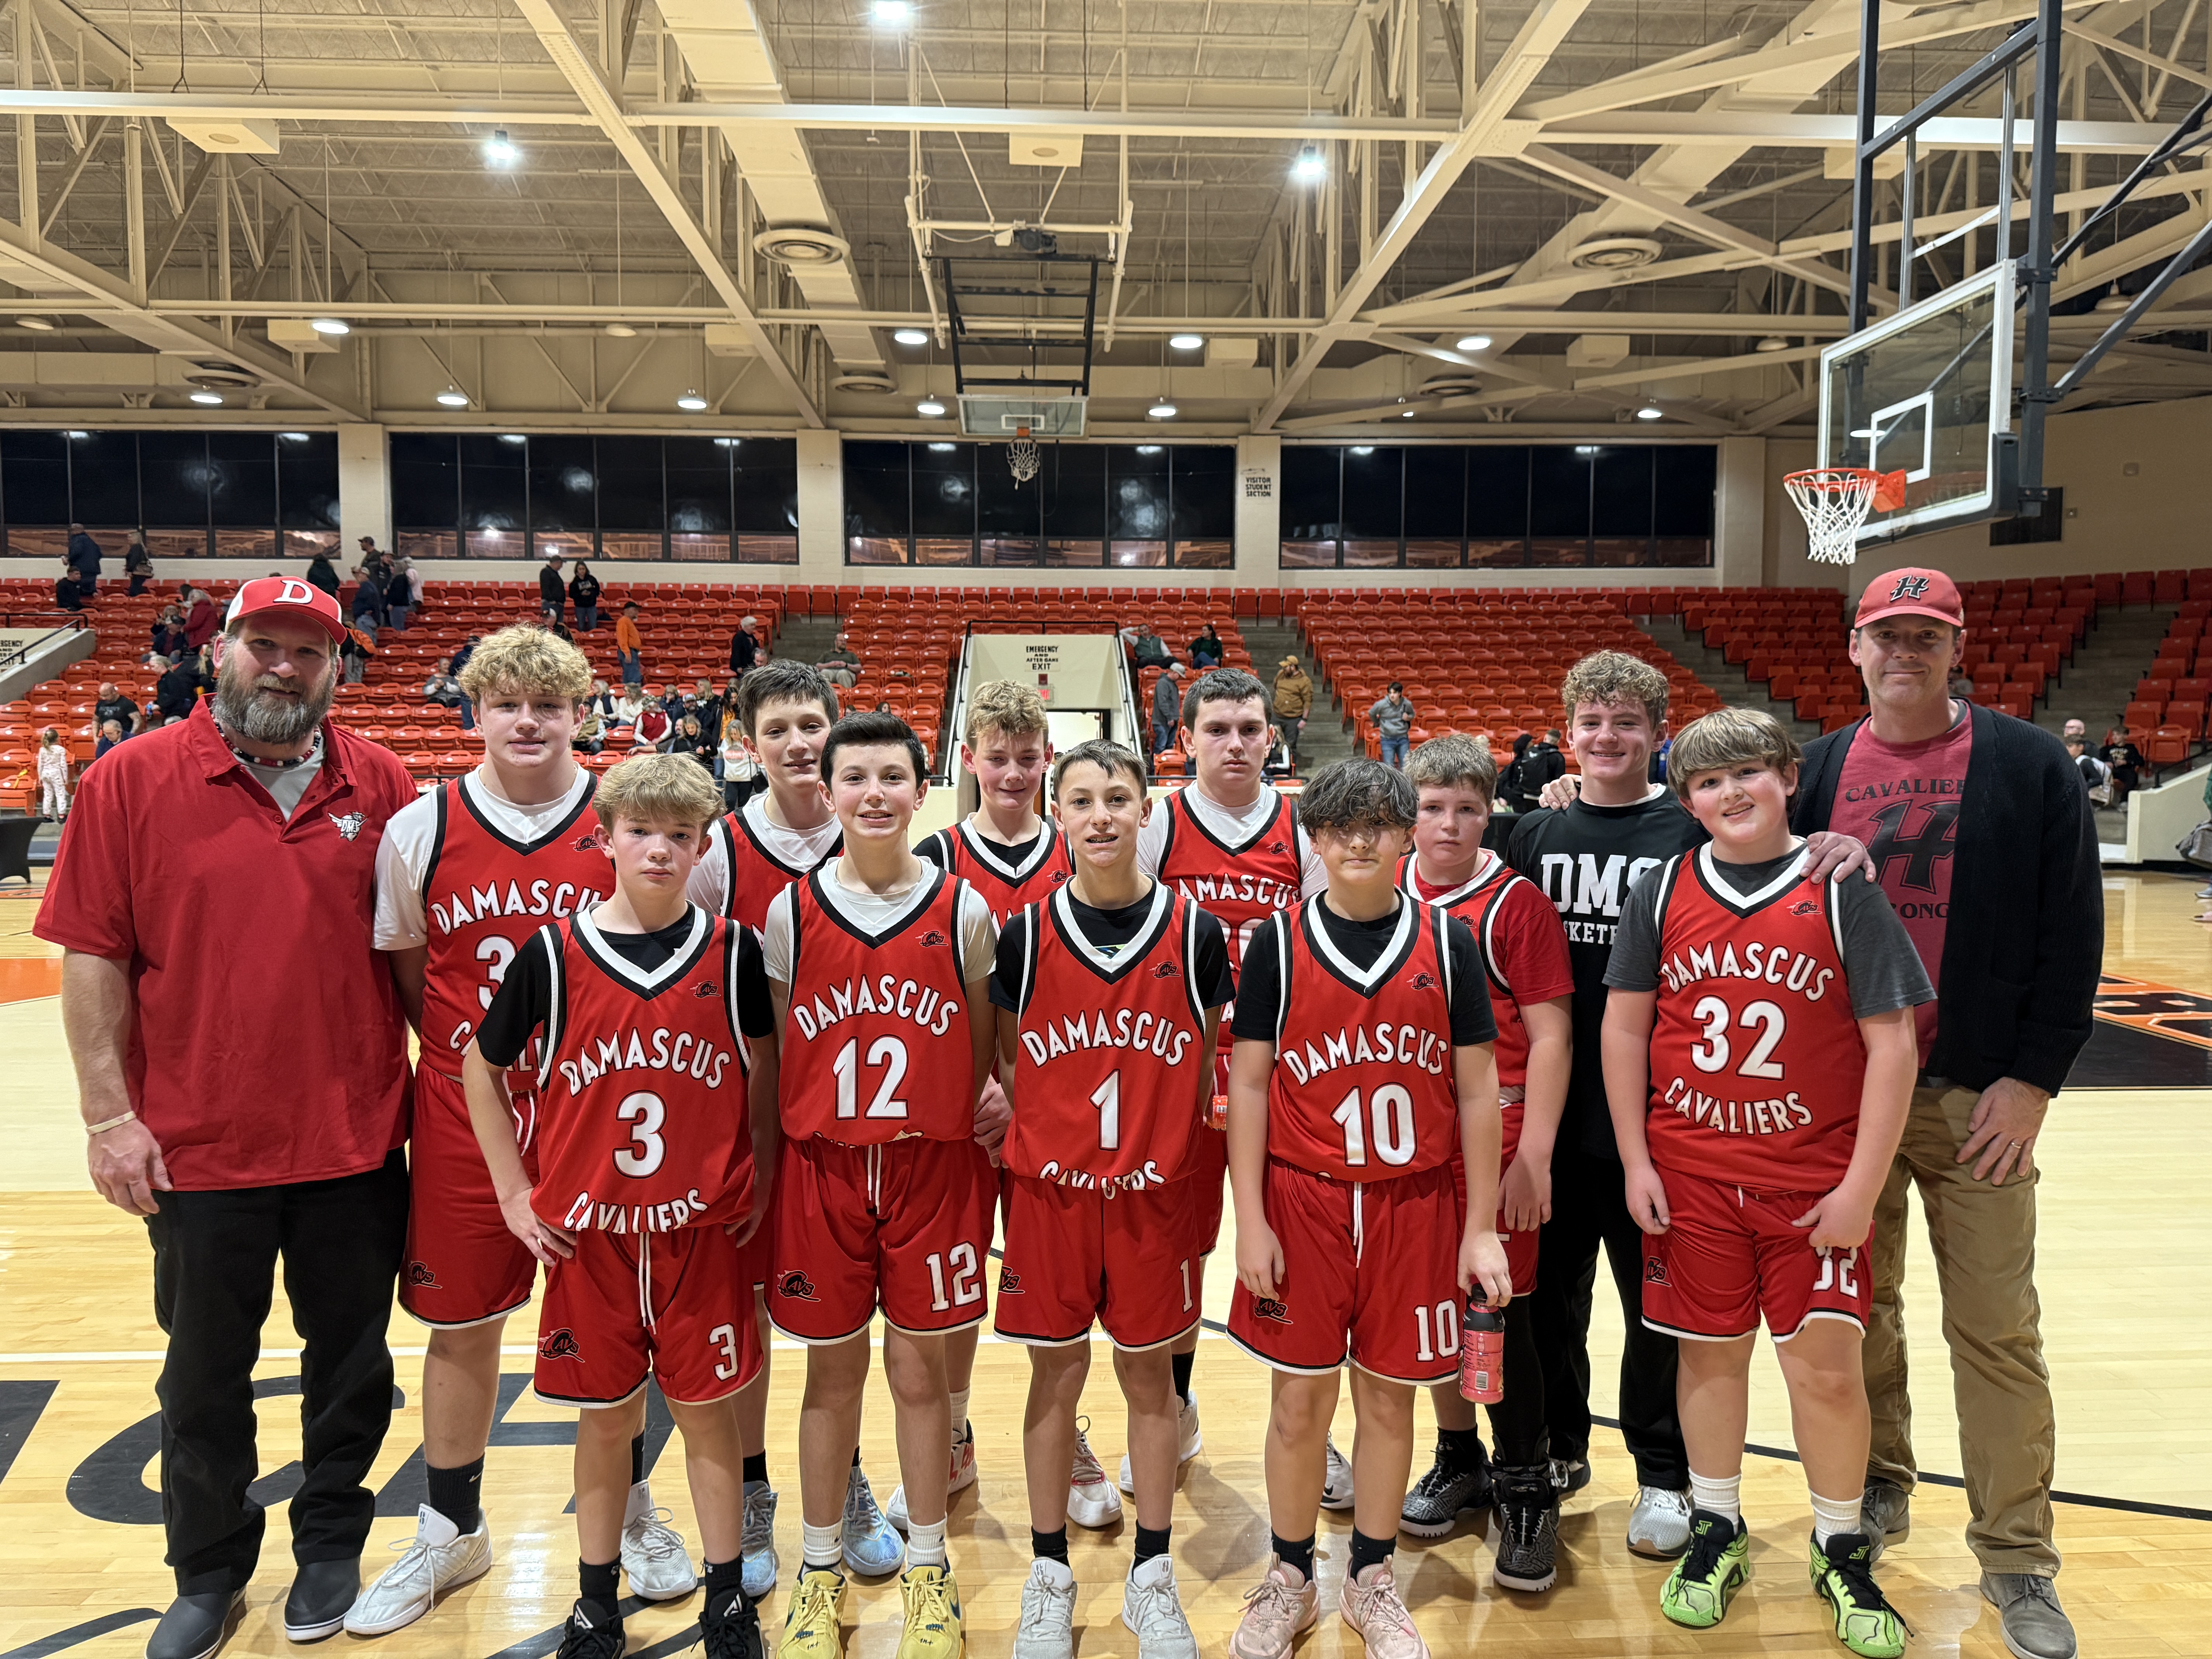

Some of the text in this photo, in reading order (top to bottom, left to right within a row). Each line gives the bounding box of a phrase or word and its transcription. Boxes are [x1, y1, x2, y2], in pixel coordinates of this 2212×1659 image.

[273, 580, 313, 604] D
[1890, 575, 1930, 602] H
[921, 930, 945, 947] CAVS
[696, 981, 718, 998] CAVS
[1155, 961, 1178, 978] CAVS
[1412, 972, 1434, 990] CAVS
[1661, 941, 1834, 1002] DAMASCUS
[793, 974, 959, 1042] DAMASCUS
[1020, 1008, 1193, 1068] DAMASCUS
[1690, 994, 1786, 1081] 32
[558, 1027, 731, 1097] DAMASCUS
[833, 1034, 908, 1120] 12
[1281, 1022, 1448, 1087] DAMASCUS
[613, 1089, 666, 1179] 3
[1089, 1068, 1120, 1151] 1
[1330, 1082, 1417, 1167] 10
[1664, 1076, 1813, 1135] CAVALIERS
[778, 1270, 815, 1297] CAVS
[924, 1241, 982, 1313] 12
[1179, 1258, 1194, 1314] 1
[542, 1328, 579, 1360] CAVS
[708, 1322, 738, 1382] 3
[1413, 1298, 1460, 1362] 10
